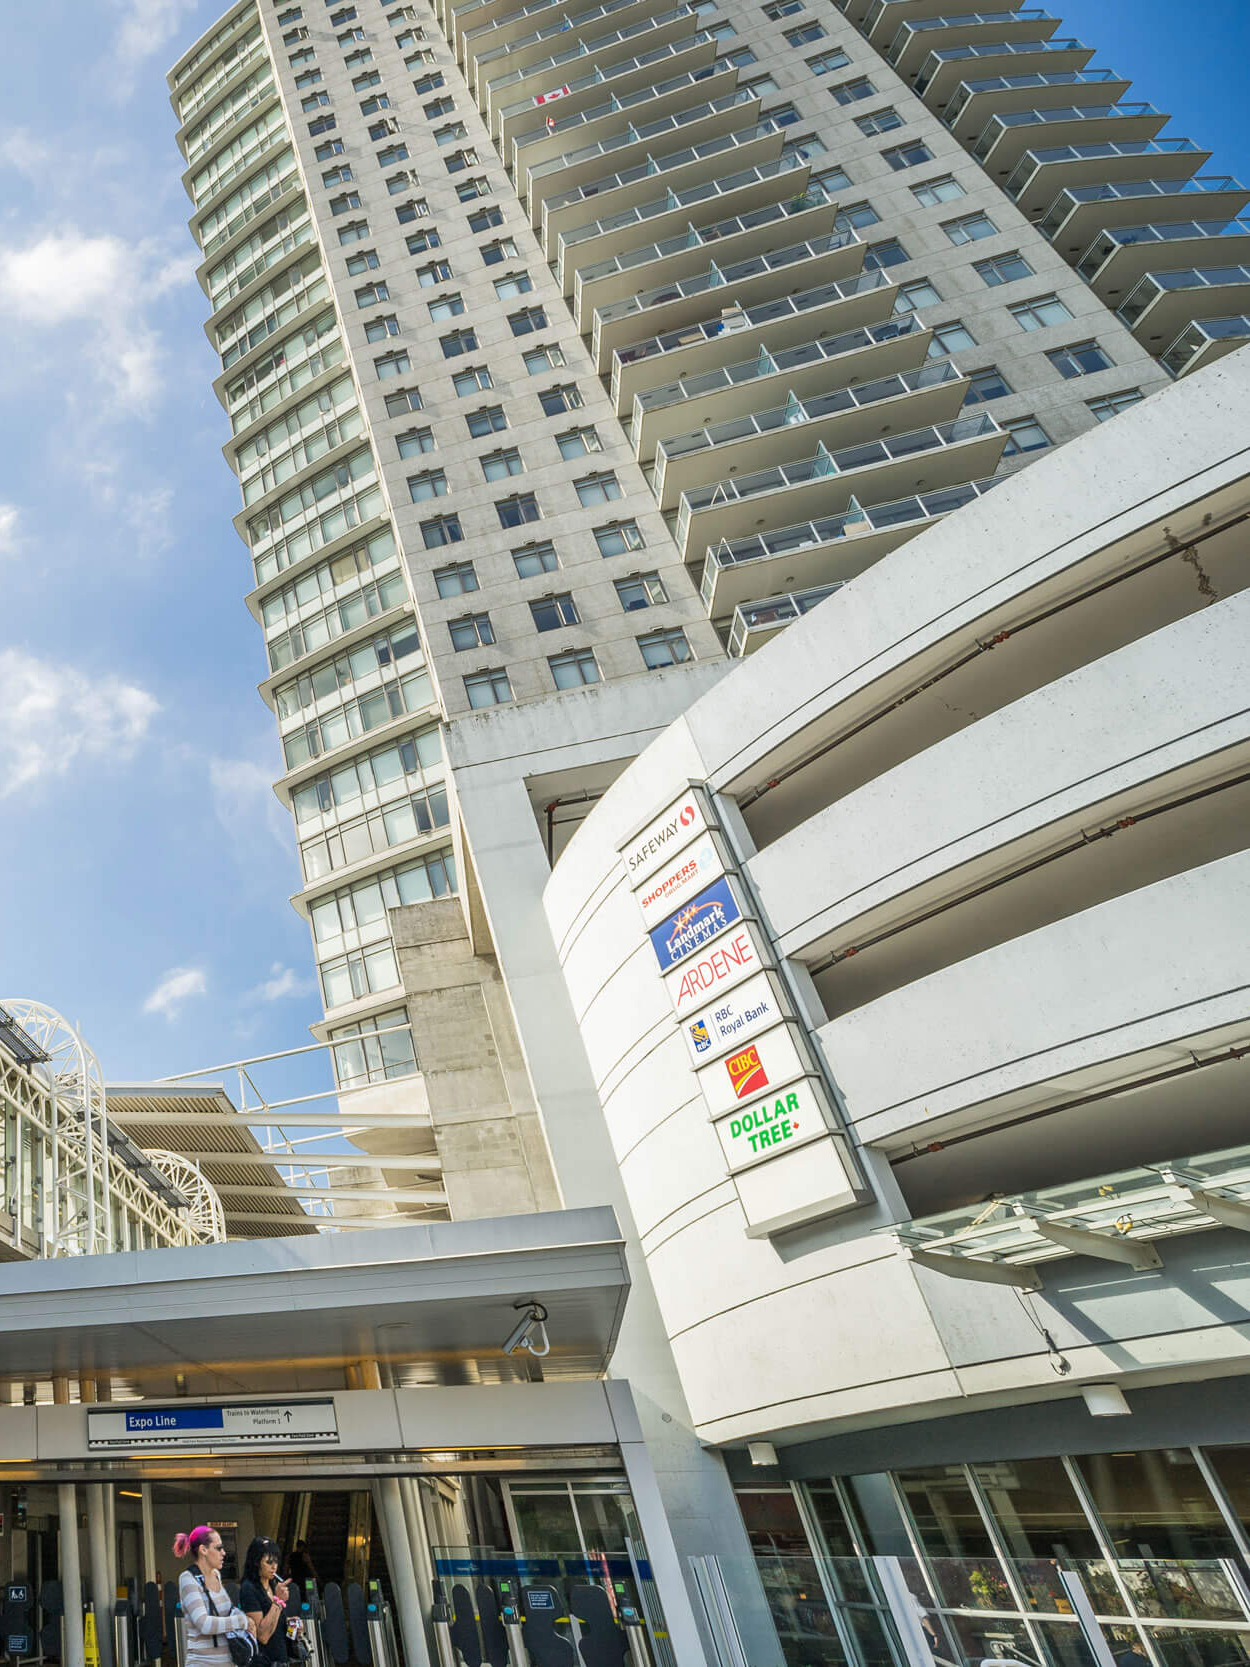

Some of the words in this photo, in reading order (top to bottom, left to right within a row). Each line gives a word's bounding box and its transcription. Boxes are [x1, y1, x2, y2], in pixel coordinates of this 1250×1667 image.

[628, 818, 679, 871] SAFEWAY
[641, 859, 697, 908] SHOPPERS
[664, 882, 682, 899] DRUG
[682, 868, 700, 886] MART
[665, 905, 725, 954] Landmark
[670, 915, 728, 962] CINEMAS
[677, 934, 753, 1007] ARDENE
[714, 1004, 734, 1023] RBC
[719, 1018, 745, 1038] Royal
[744, 1001, 770, 1023] Bank
[696, 1039, 712, 1052] RBC
[728, 1049, 759, 1077] CIBC
[730, 1092, 800, 1139] DOLLAR
[747, 1119, 793, 1153] TREE
[129, 1416, 153, 1429] Expo
[155, 1415, 177, 1427] Line
[250, 1408, 280, 1416] Waterfront
